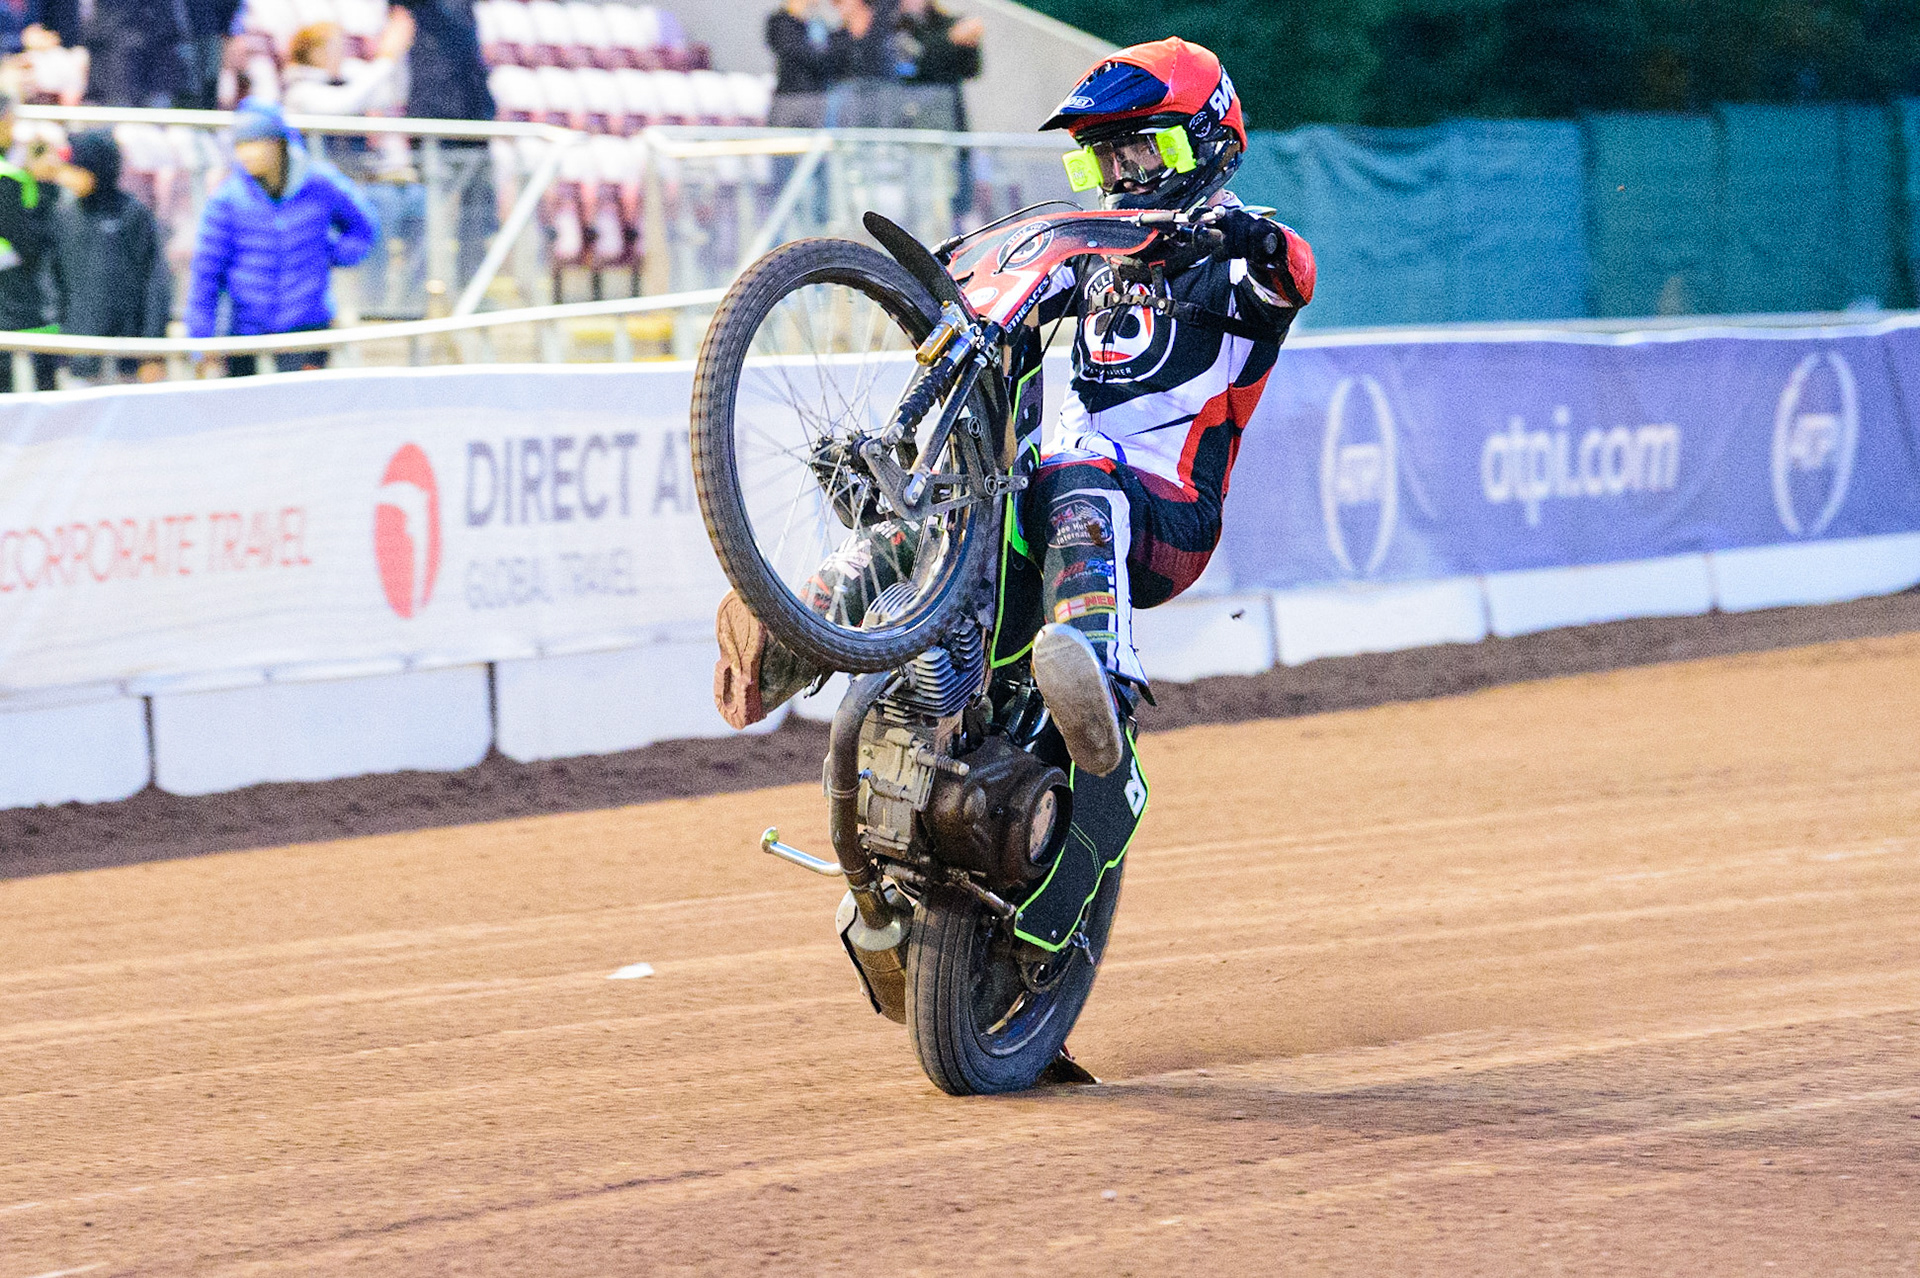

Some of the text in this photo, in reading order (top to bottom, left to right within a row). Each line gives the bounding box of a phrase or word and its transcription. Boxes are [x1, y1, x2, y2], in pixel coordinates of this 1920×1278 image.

[466, 428, 697, 528] DIRECT AT
[1481, 405, 1682, 527] atpi.com
[0, 505, 314, 592] CORPORATE TRAVEL
